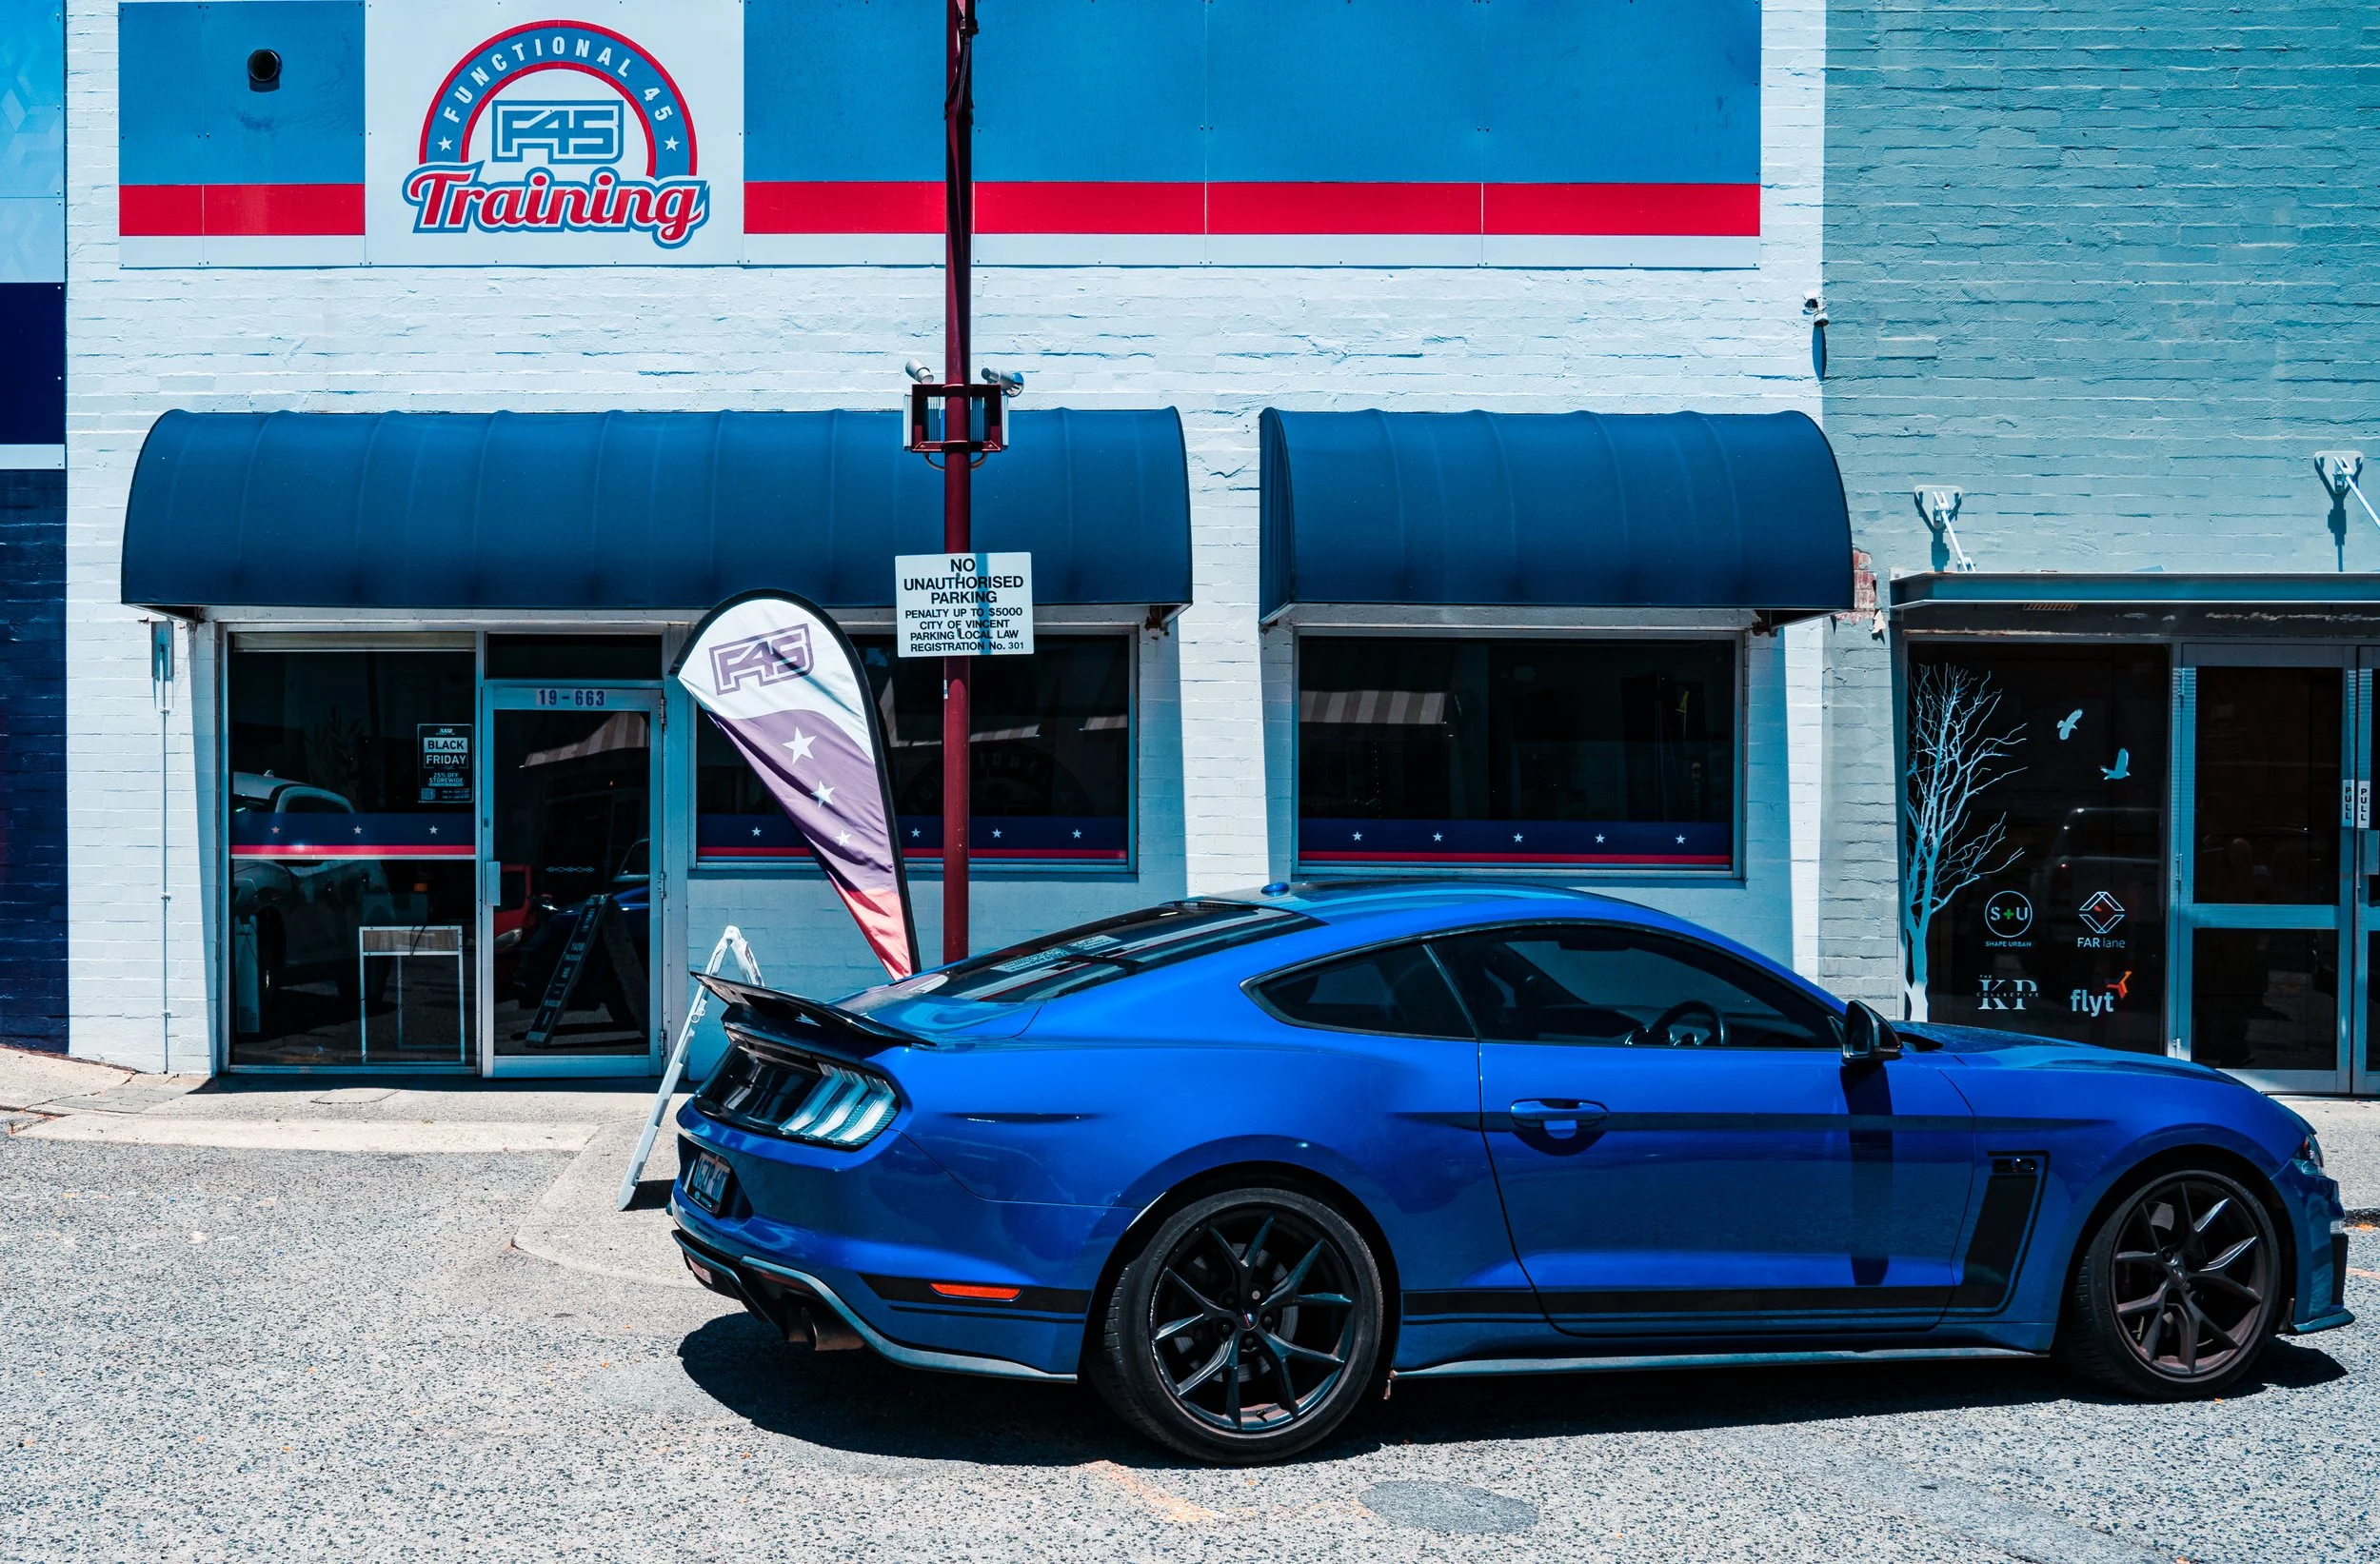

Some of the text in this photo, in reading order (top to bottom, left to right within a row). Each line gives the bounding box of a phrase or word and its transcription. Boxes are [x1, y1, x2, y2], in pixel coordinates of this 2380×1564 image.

[443, 36, 674, 125] FUNCTIONAL 45
[495, 103, 622, 162] F45
[407, 167, 707, 246] Training
[950, 558, 976, 572] NO
[903, 575, 1024, 591] UNAUTHORISED
[930, 590, 998, 604] PARKING
[904, 606, 1023, 619] PENALTY UP TO $5000
[919, 619, 1010, 630] CITY OF VINCENT
[910, 629, 1020, 641] PARKING LOCAL LAW
[910, 642, 1024, 652] REGISTRATION No. 301
[710, 624, 813, 695] F45
[427, 740, 465, 750] BLACK
[426, 754, 466, 764] FRIDAY
[2077, 937, 2126, 949] FAR lane
[2070, 989, 2114, 1017] flyt
